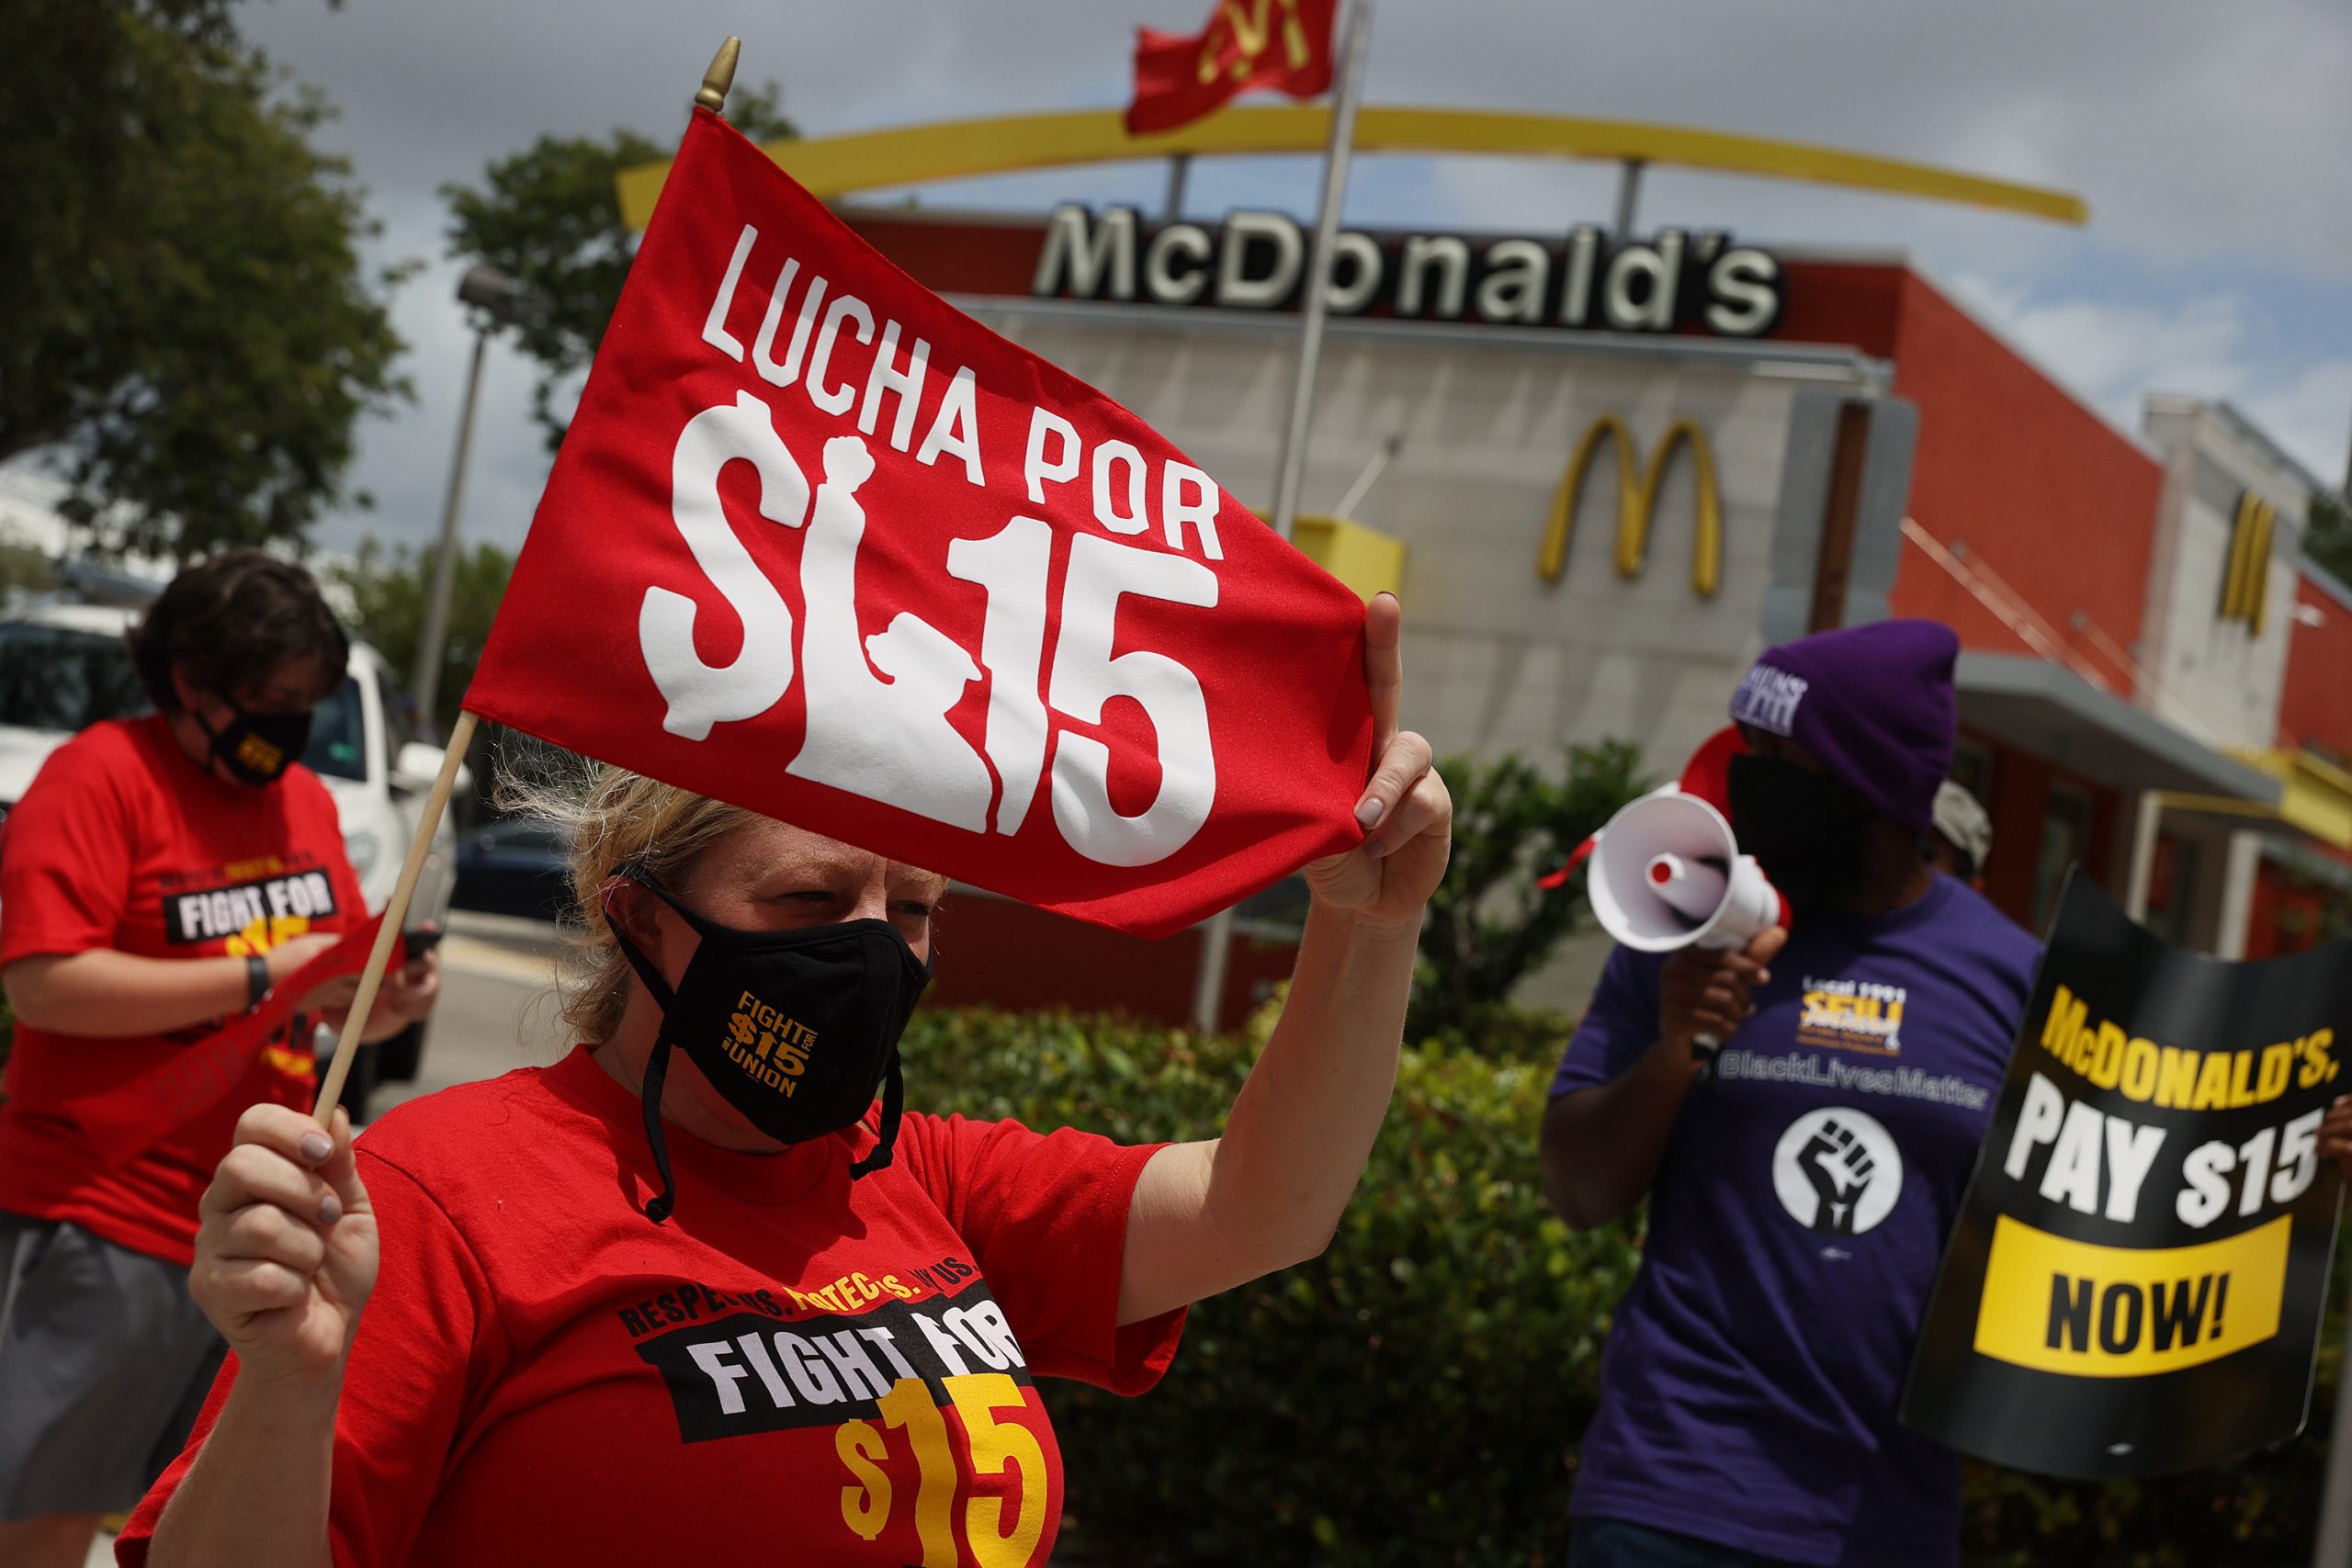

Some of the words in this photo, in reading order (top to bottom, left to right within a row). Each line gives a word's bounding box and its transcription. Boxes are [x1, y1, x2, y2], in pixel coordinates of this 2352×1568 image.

[1032, 204, 1780, 336] McDonald's
[702, 224, 985, 486] LUCHA
[1023, 406, 1224, 560] POR
[177, 886, 266, 940] FIGHT
[266, 872, 334, 919] FOR
[738, 990, 818, 1044] FIGHT
[1859, 982, 1906, 1005] 1991
[728, 1012, 809, 1076] $15
[729, 1042, 797, 1098] UNION
[2041, 983, 2341, 1111] McDONALD'S,
[2004, 1071, 2167, 1224] PAY
[2176, 1108, 2324, 1228] $15
[685, 1327, 921, 1415] FIGHT
[911, 1299, 1027, 1376] FOR
[2045, 1271, 2231, 1355] NOW!
[834, 1372, 1048, 1568] $15
